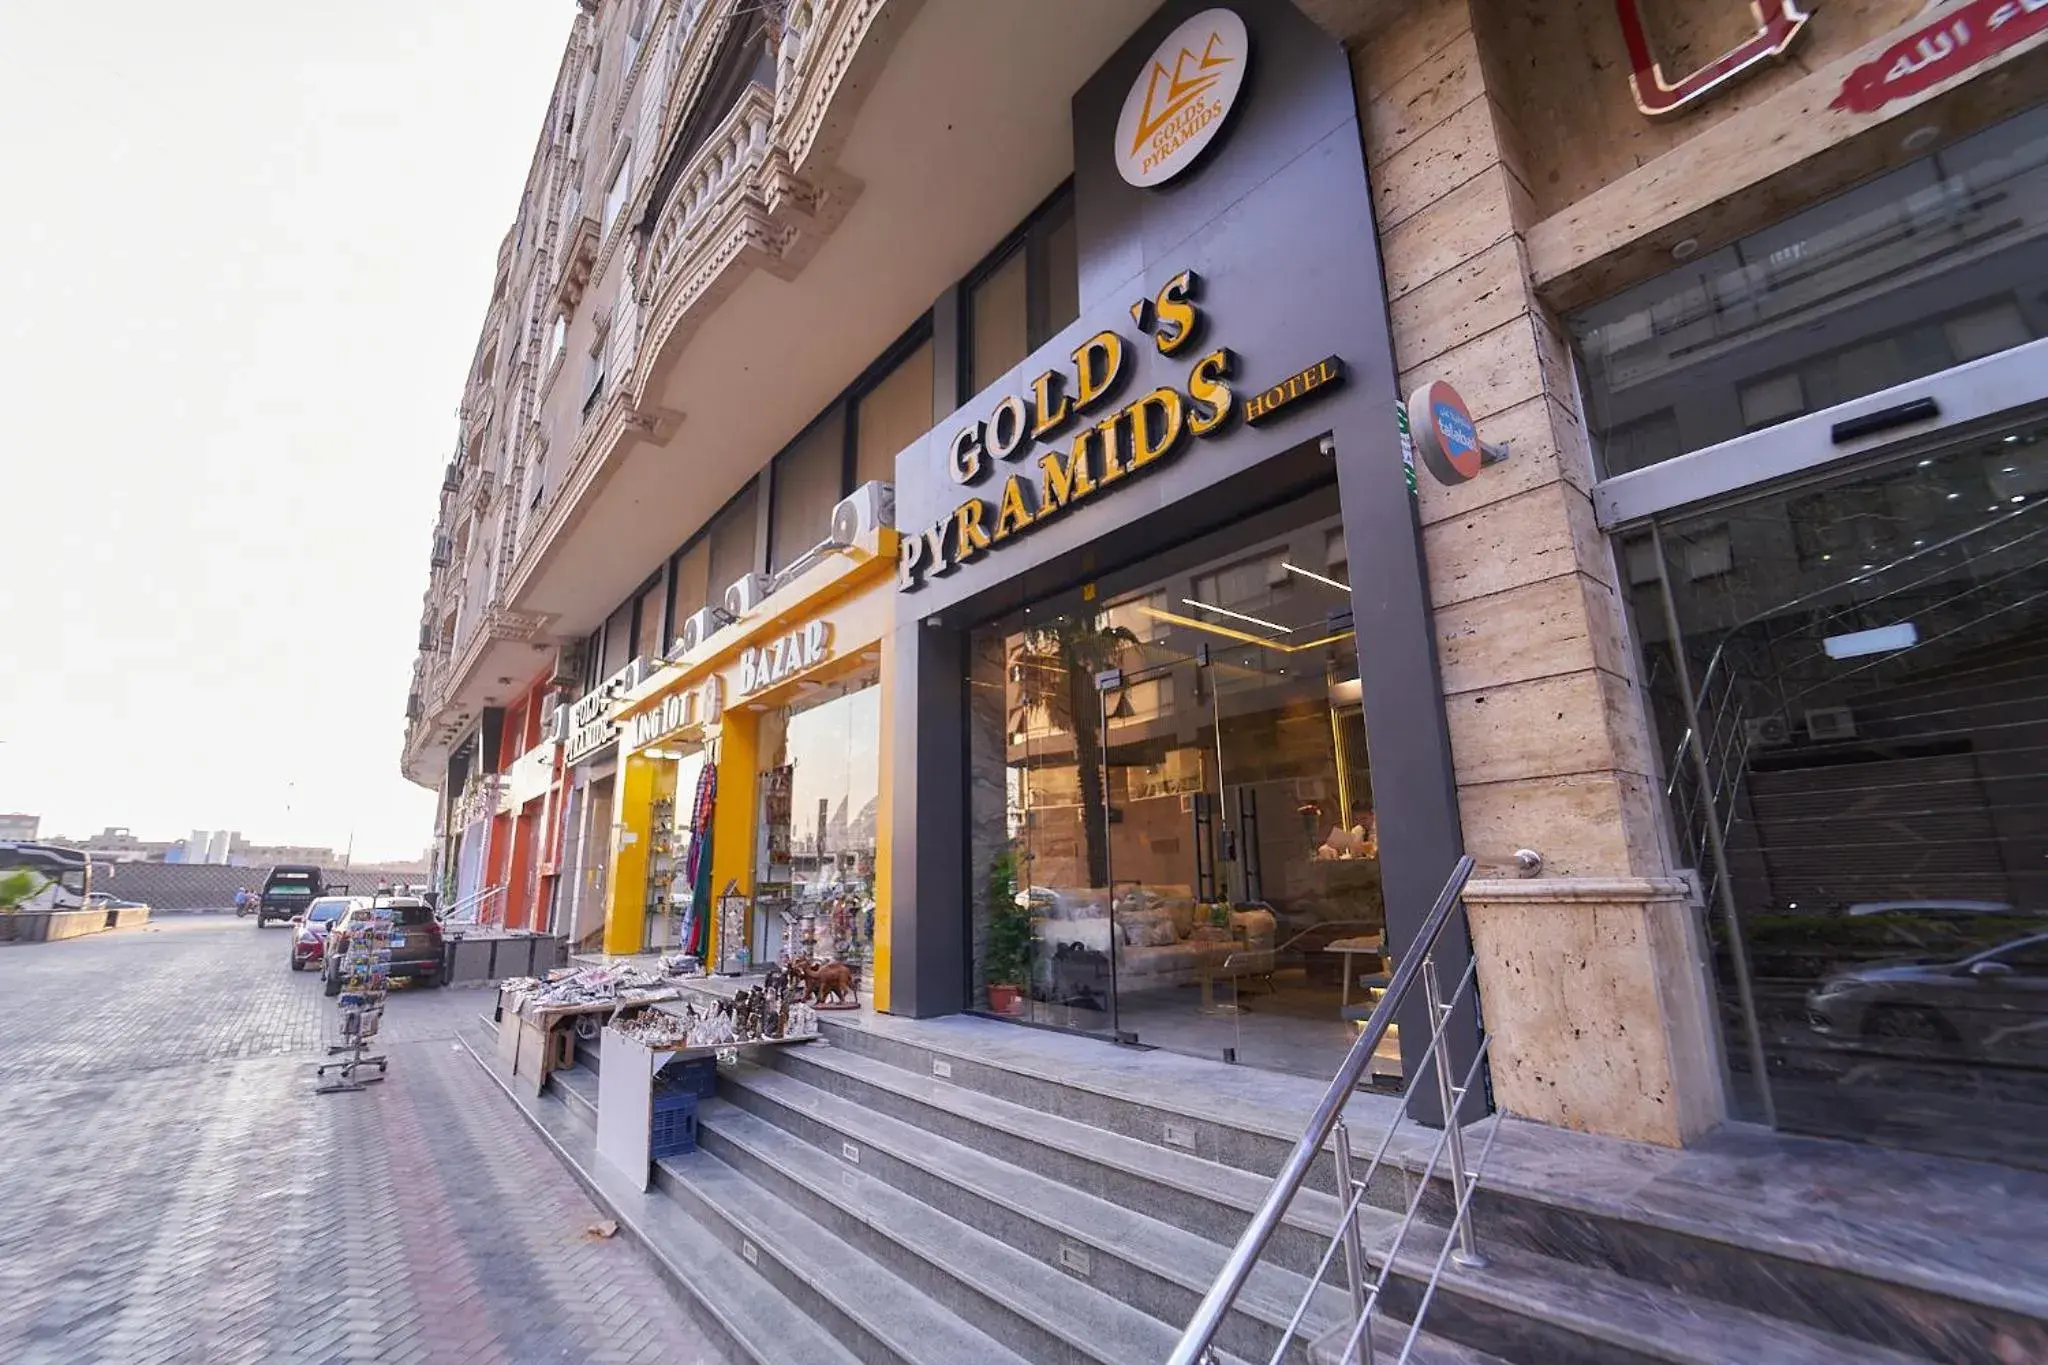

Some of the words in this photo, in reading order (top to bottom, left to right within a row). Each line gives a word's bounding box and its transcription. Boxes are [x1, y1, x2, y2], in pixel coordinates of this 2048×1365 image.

[1884, 18, 1972, 84] الله
[1142, 99, 1222, 175] PYRAMIDS
[1152, 95, 1205, 148] GOLDS
[897, 347, 1237, 592] PYRAMIDS
[1245, 362, 1337, 422] HOTEL
[739, 619, 828, 695] BAZAR
